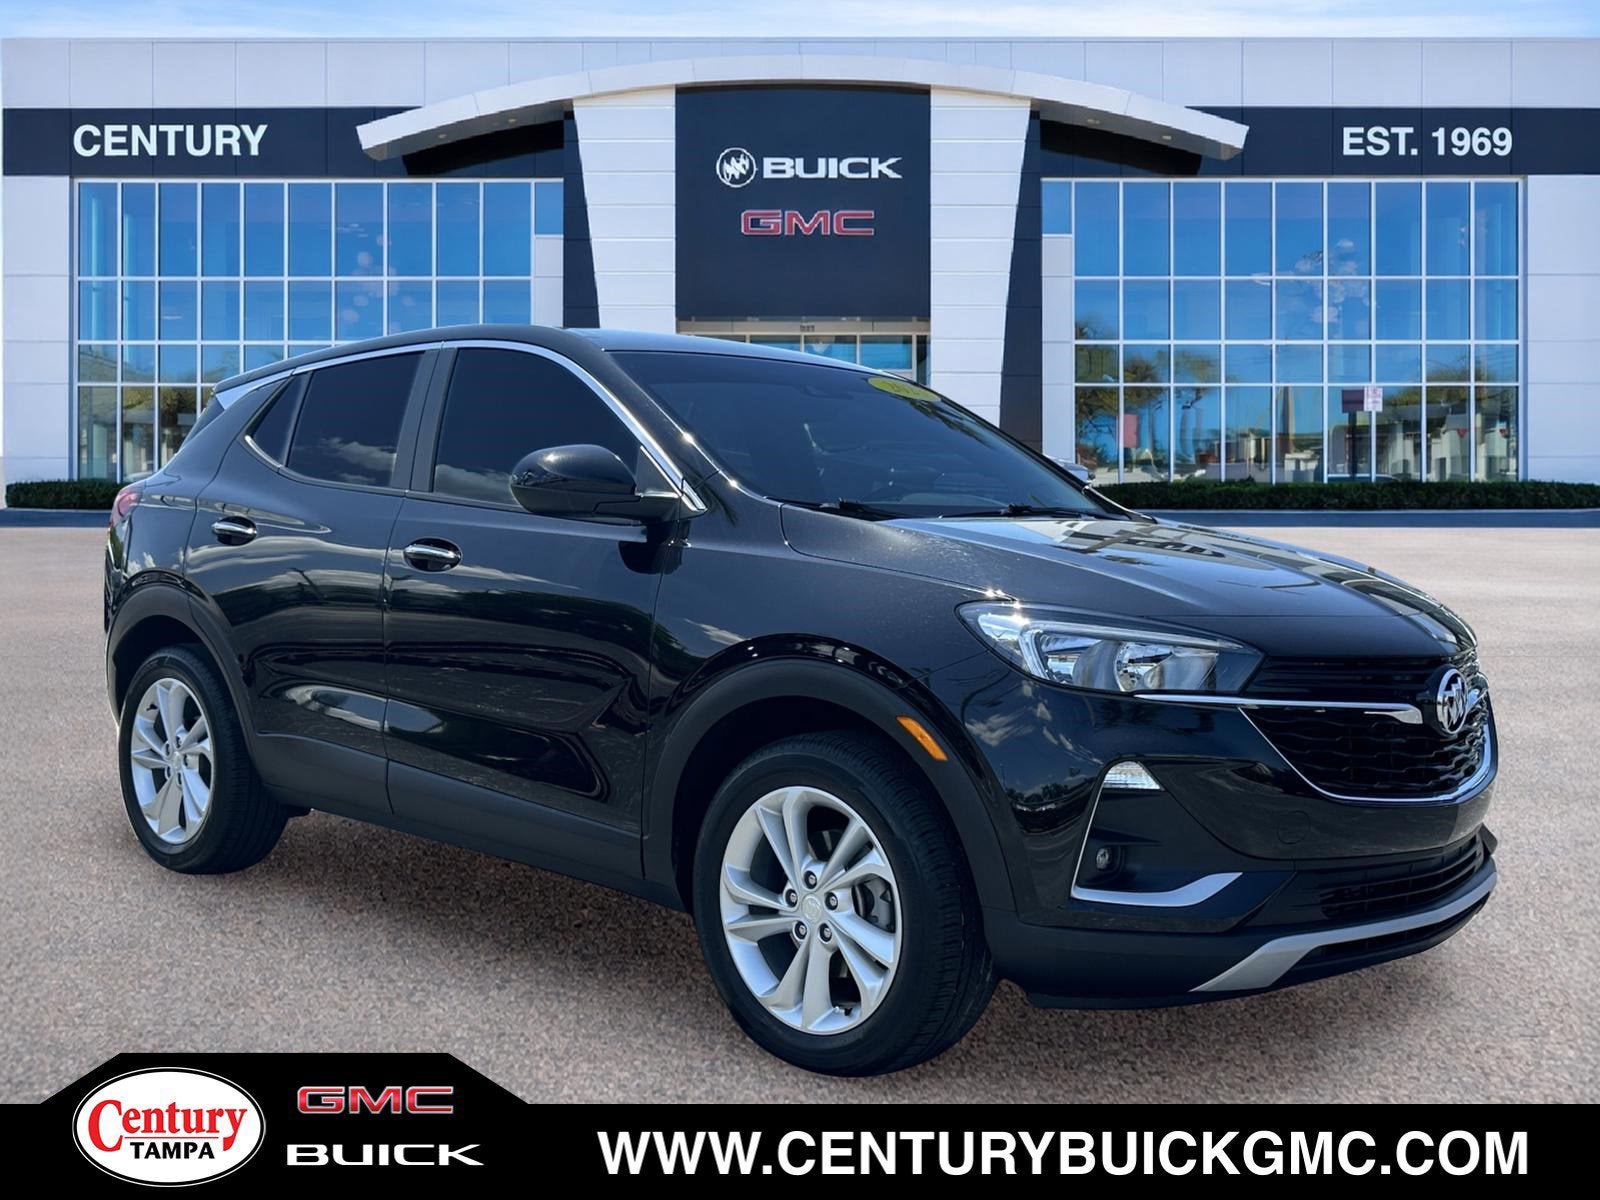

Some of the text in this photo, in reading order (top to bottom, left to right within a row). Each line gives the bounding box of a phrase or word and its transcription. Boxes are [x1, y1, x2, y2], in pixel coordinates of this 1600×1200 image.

[73, 124, 268, 157] CENTURY
[1342, 127, 1513, 156] EST. 1969
[762, 157, 903, 179] BUICK
[740, 209, 875, 236] GMC
